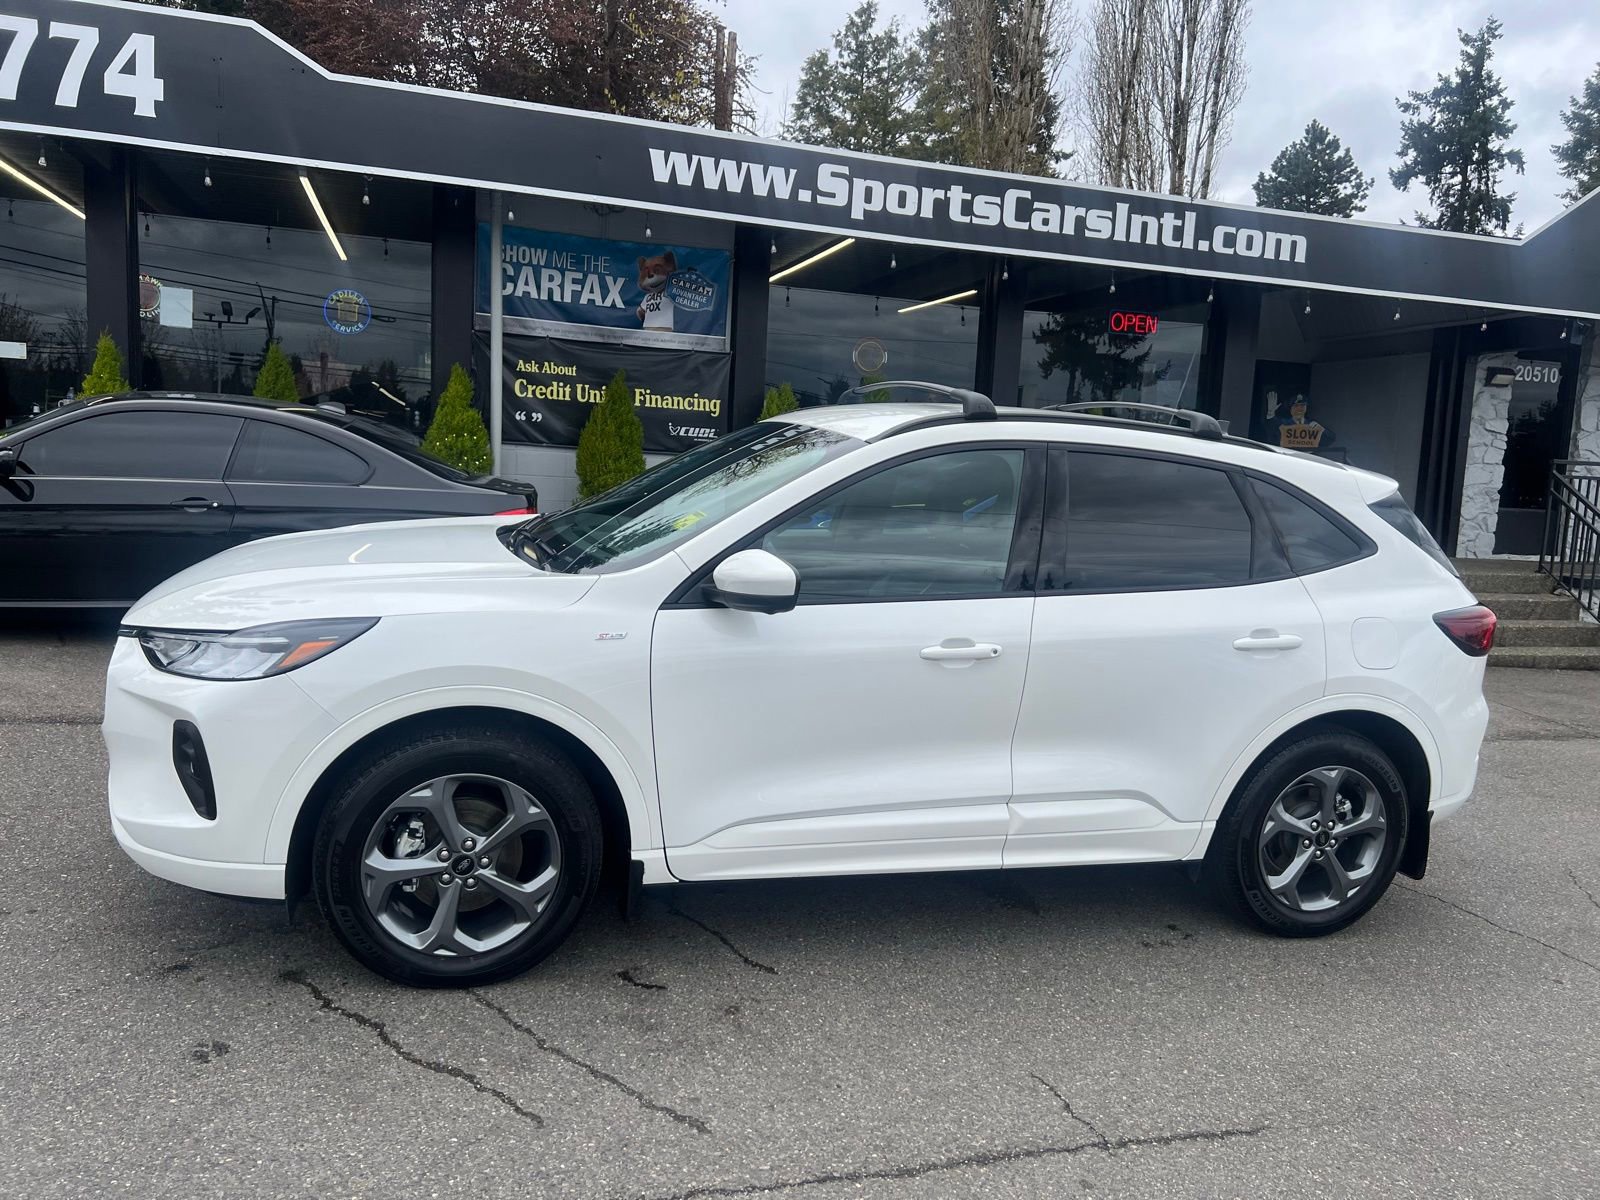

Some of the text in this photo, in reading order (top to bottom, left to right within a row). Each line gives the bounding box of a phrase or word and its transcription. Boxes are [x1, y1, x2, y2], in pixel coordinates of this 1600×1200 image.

[0, 14, 164, 118] 774
[649, 148, 1307, 263] www.SportsCarsIntl.com
[552, 250, 577, 270] ME
[581, 254, 610, 274] THE
[501, 262, 625, 309] CARFAX
[672, 278, 713, 296] CARFAX
[646, 292, 664, 303] CAR
[672, 287, 708, 304] ADVANTAGE
[675, 297, 700, 309] DEALER
[645, 301, 661, 312] FOX
[1111, 312, 1158, 334] OPEN
[516, 360, 577, 376] Ask About
[1514, 365, 1559, 384] 20510
[514, 379, 721, 417] Credit Uni Financing
[1286, 428, 1319, 440] SLOW
